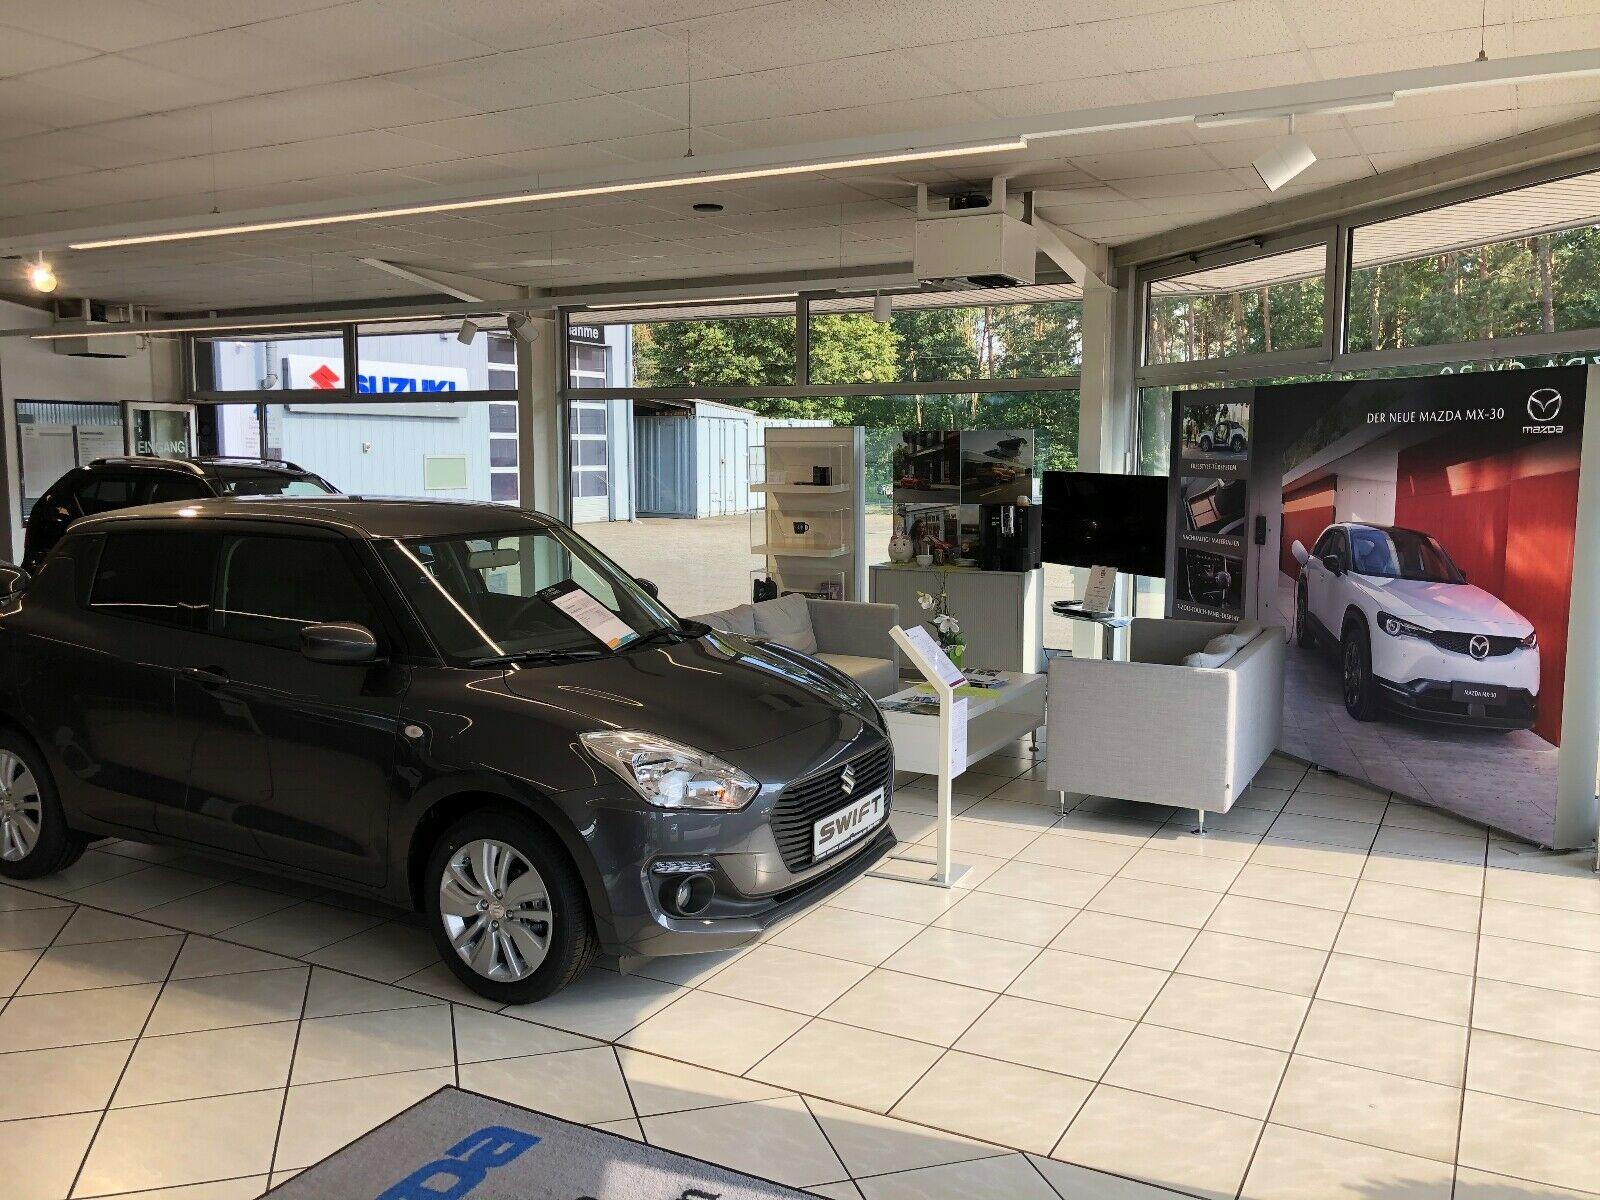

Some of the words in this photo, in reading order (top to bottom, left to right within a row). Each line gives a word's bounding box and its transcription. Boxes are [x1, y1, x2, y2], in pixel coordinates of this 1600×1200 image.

[1366, 412, 1386, 424] DER
[1389, 411, 1416, 423] NEUE
[1419, 409, 1462, 422] MAZDA
[1465, 407, 1505, 421] MX-30
[818, 794, 882, 846] SWIFT
